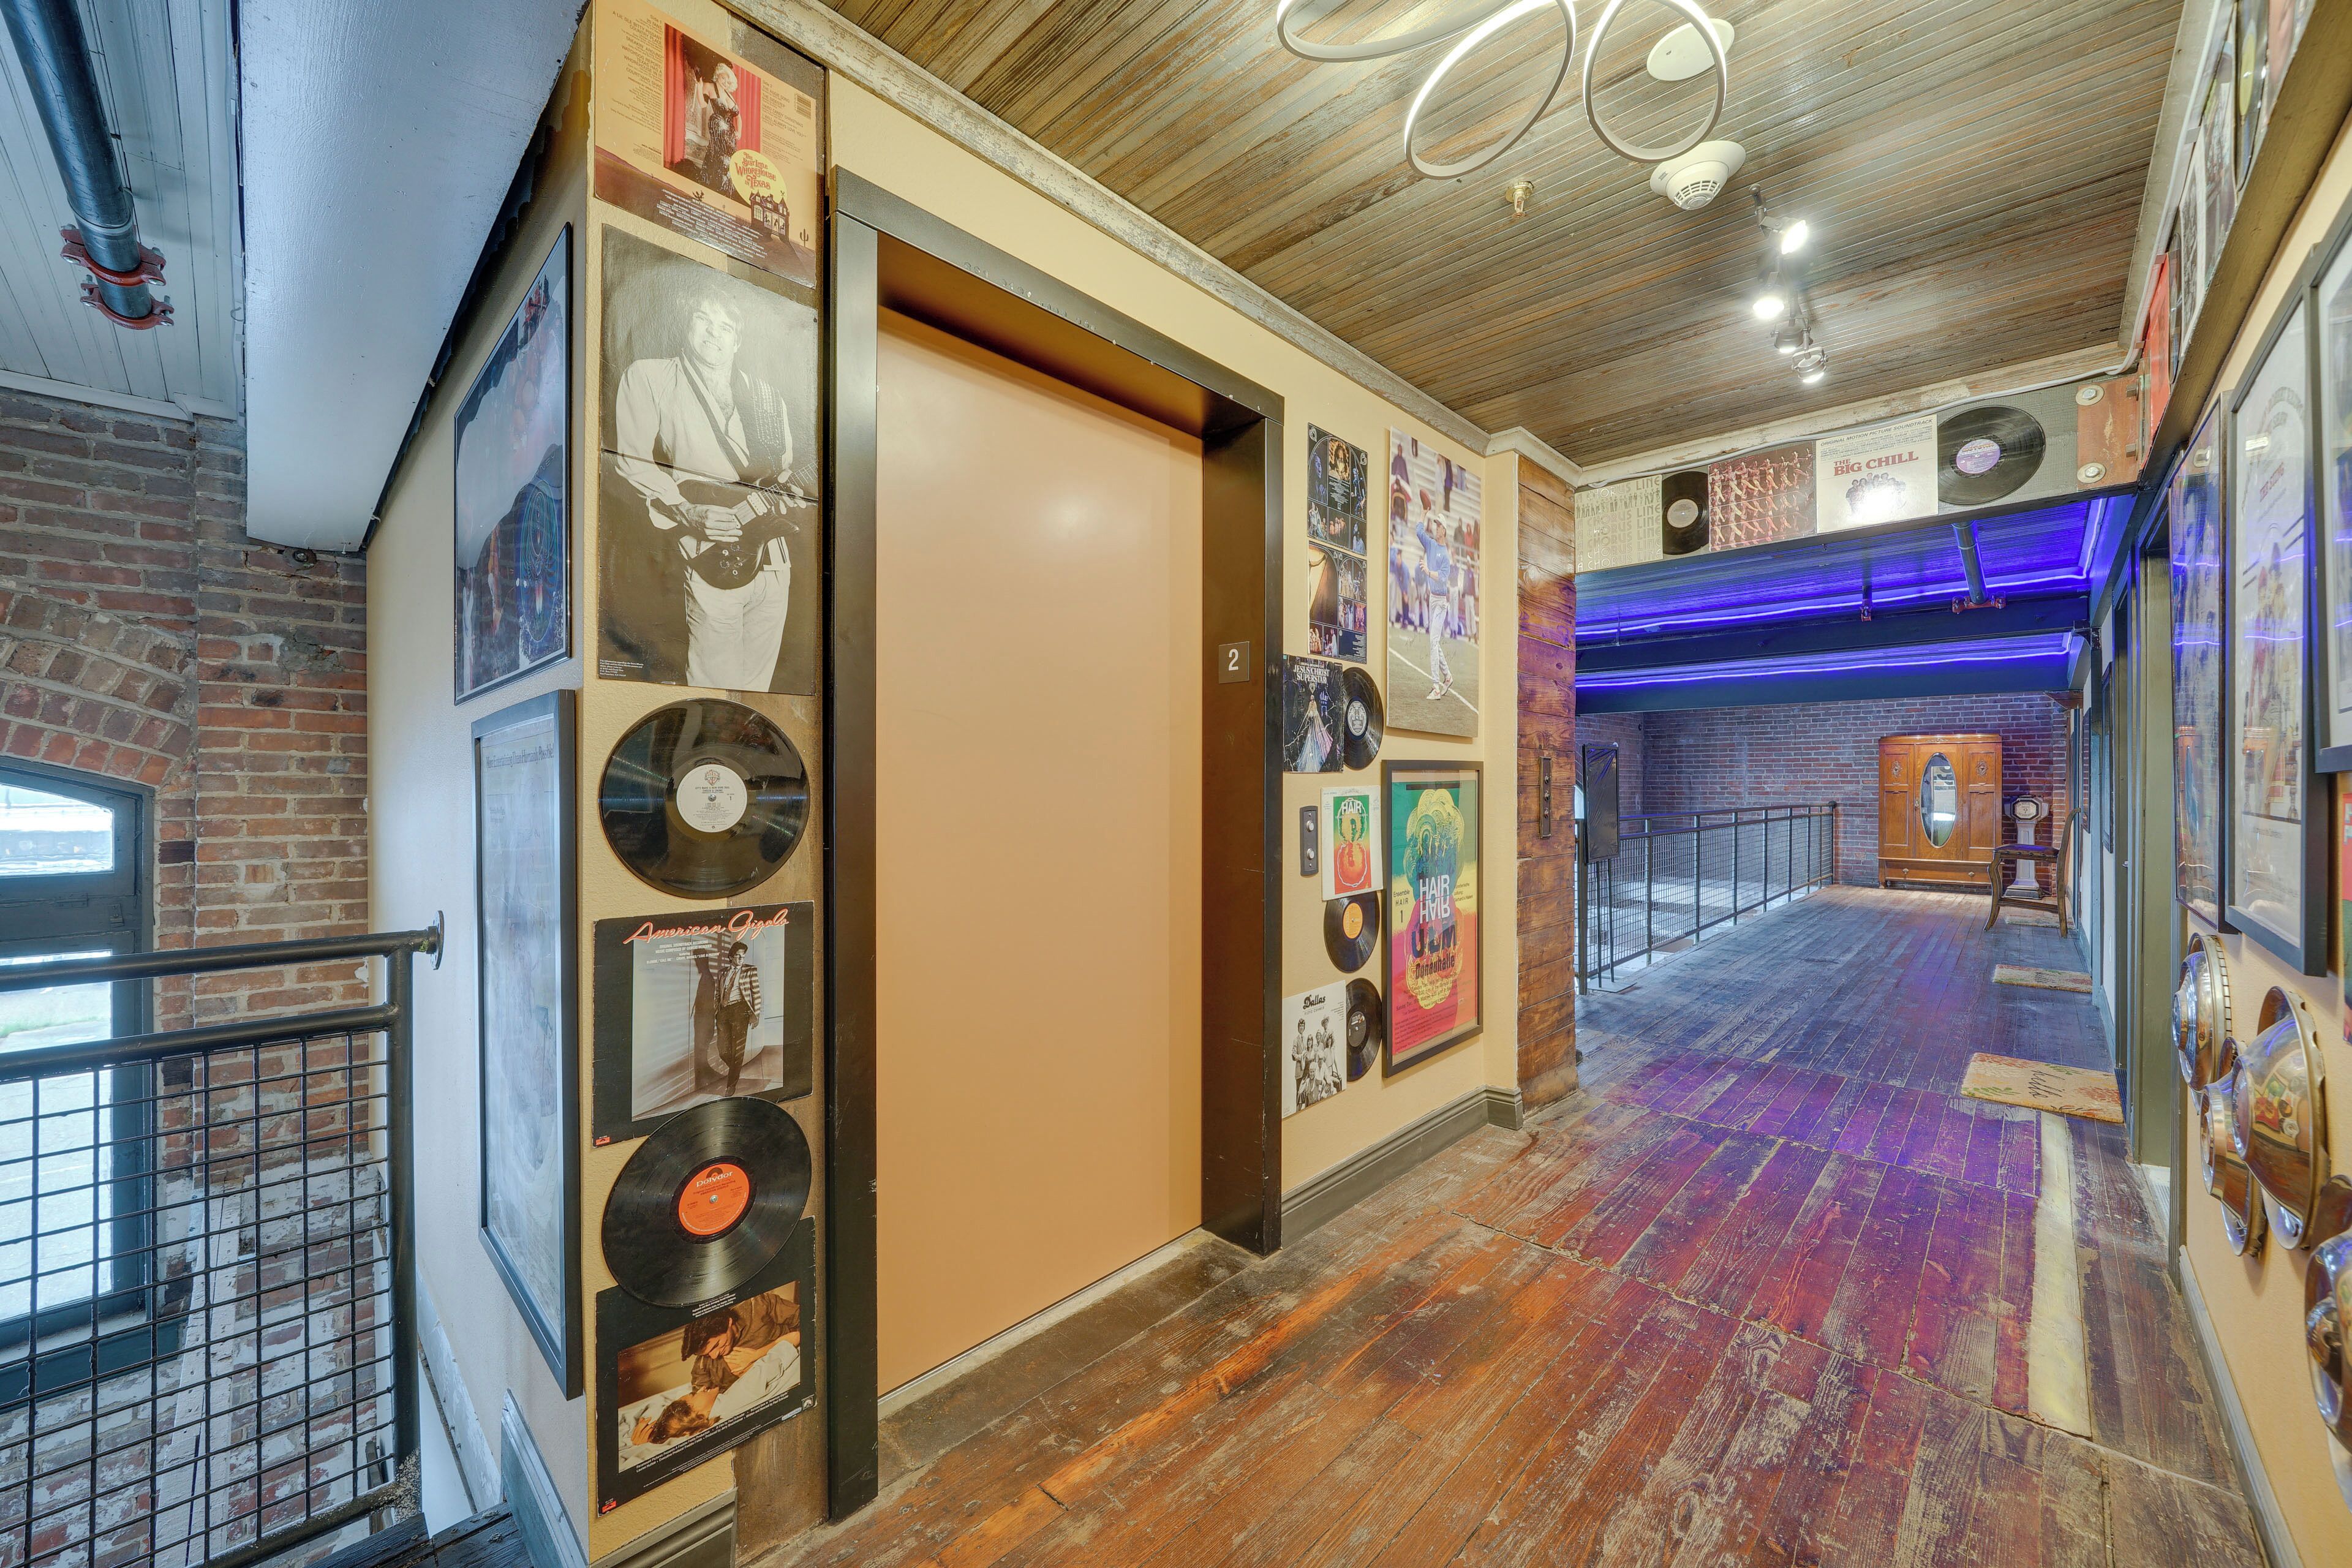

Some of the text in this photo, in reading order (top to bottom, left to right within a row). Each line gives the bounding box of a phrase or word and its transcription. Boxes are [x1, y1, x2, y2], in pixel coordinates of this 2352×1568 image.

[1869, 428, 1892, 436] PICTURE
[1893, 418, 1934, 431] SOUNDTRACK
[1834, 451, 1919, 477] BIG CHILL
[1587, 482, 1632, 500] CHORUS
[1637, 476, 1660, 490] LINE
[1588, 510, 1632, 526] CHORUS
[1637, 504, 1660, 518] LINE
[1637, 514, 1660, 529] LINE
[1637, 527, 1661, 540] LINE
[1588, 542, 1632, 559] CHORUS
[1637, 538, 1661, 551] LINE
[1577, 548, 1662, 572] A CHORUS LINE
[1229, 649, 1238, 671] 2
[1294, 665, 1330, 677] JESUS CHRIST
[1297, 673, 1328, 684] SUPERSTAR
[512, 751, 522, 764] Than
[522, 747, 538, 764] Humanly
[1341, 801, 1362, 815] HAIR
[1420, 874, 1450, 902] HAIR
[1395, 898, 1409, 907] HAIR
[623, 908, 790, 944] American Gigolo
[1415, 952, 1455, 980] Donauhalle
[1303, 995, 1326, 1010] Dallas
[2028, 1069, 2066, 1099] hello
[696, 1172, 733, 1187] polydor
[636, 1459, 652, 1469] Paramount
[696, 1430, 710, 1439] Production
